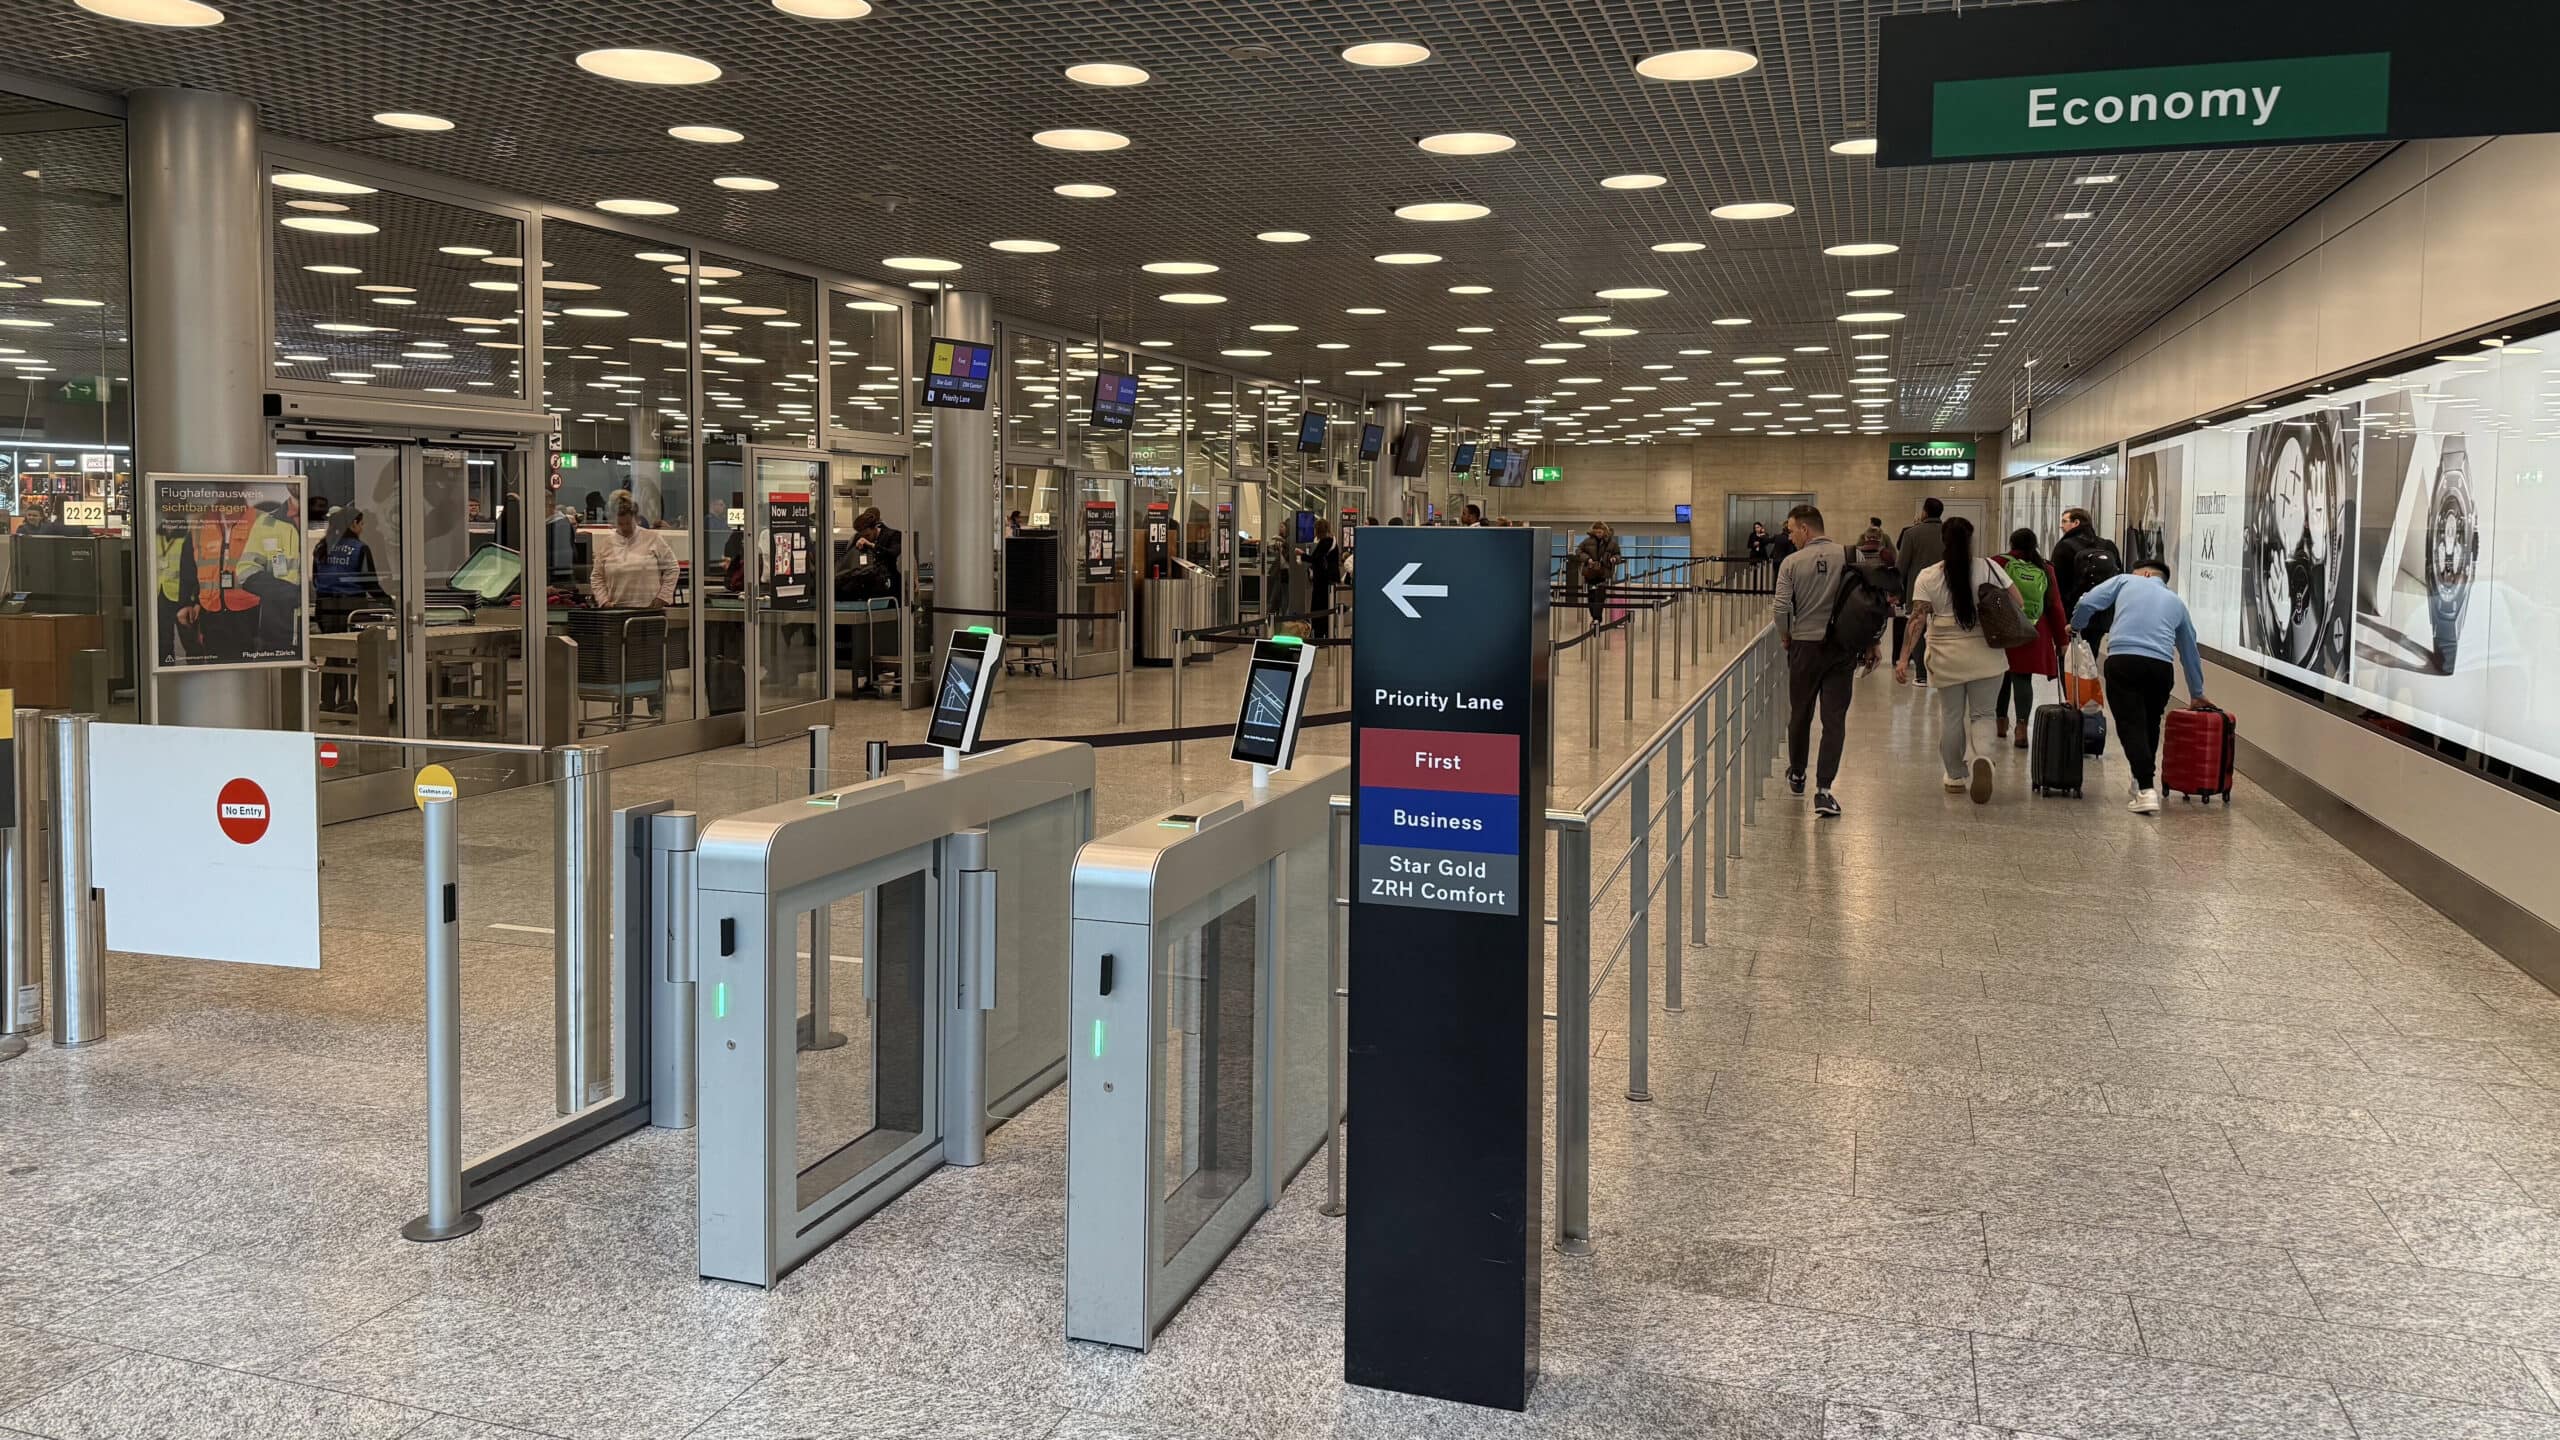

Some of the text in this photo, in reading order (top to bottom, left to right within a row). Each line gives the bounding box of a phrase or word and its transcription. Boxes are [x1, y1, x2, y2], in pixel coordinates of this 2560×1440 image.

[2029, 86, 2281, 127] Economy
[942, 394, 959, 404] Priority
[1902, 445, 1965, 458] Economy
[161, 487, 263, 500] Flughafenausweis
[67, 507, 101, 519] 22 22
[161, 503, 247, 515] sichtbar tragen
[771, 505, 808, 517] Now Jetzt
[242, 650, 274, 658] Flughafen
[1375, 689, 1504, 712] Priority Lane
[1415, 751, 1461, 770] First
[226, 806, 262, 817] No Entry
[1393, 809, 1483, 831] Business
[1389, 856, 1486, 879] Star Gold
[1371, 879, 1505, 905] ZRH Comfort
